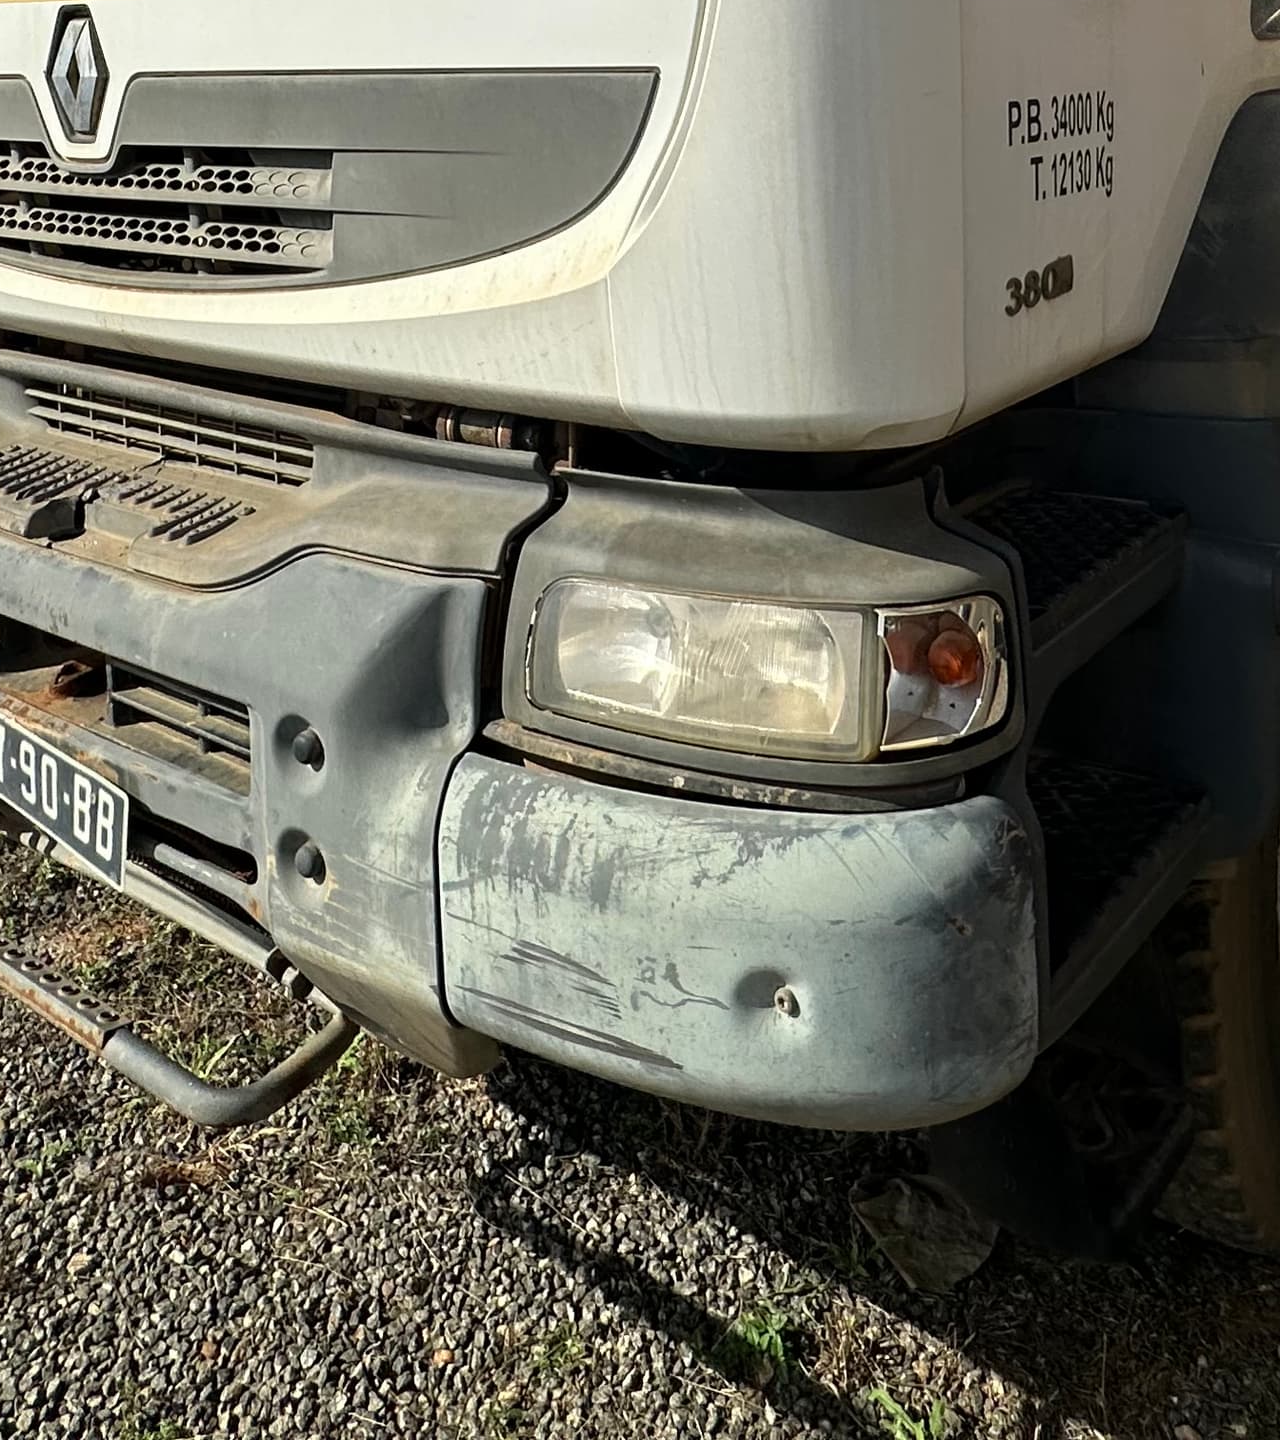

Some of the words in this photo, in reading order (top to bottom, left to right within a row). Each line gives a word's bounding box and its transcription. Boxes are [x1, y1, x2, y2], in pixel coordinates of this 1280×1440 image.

[1007, 99, 1048, 146] P.B.
[1051, 92, 1093, 140] 34000
[1096, 90, 1114, 142] Kg
[1030, 156, 1046, 201] T.
[1051, 149, 1092, 197] 12130
[1095, 146, 1114, 198] Kg
[1004, 257, 1059, 317] 380
